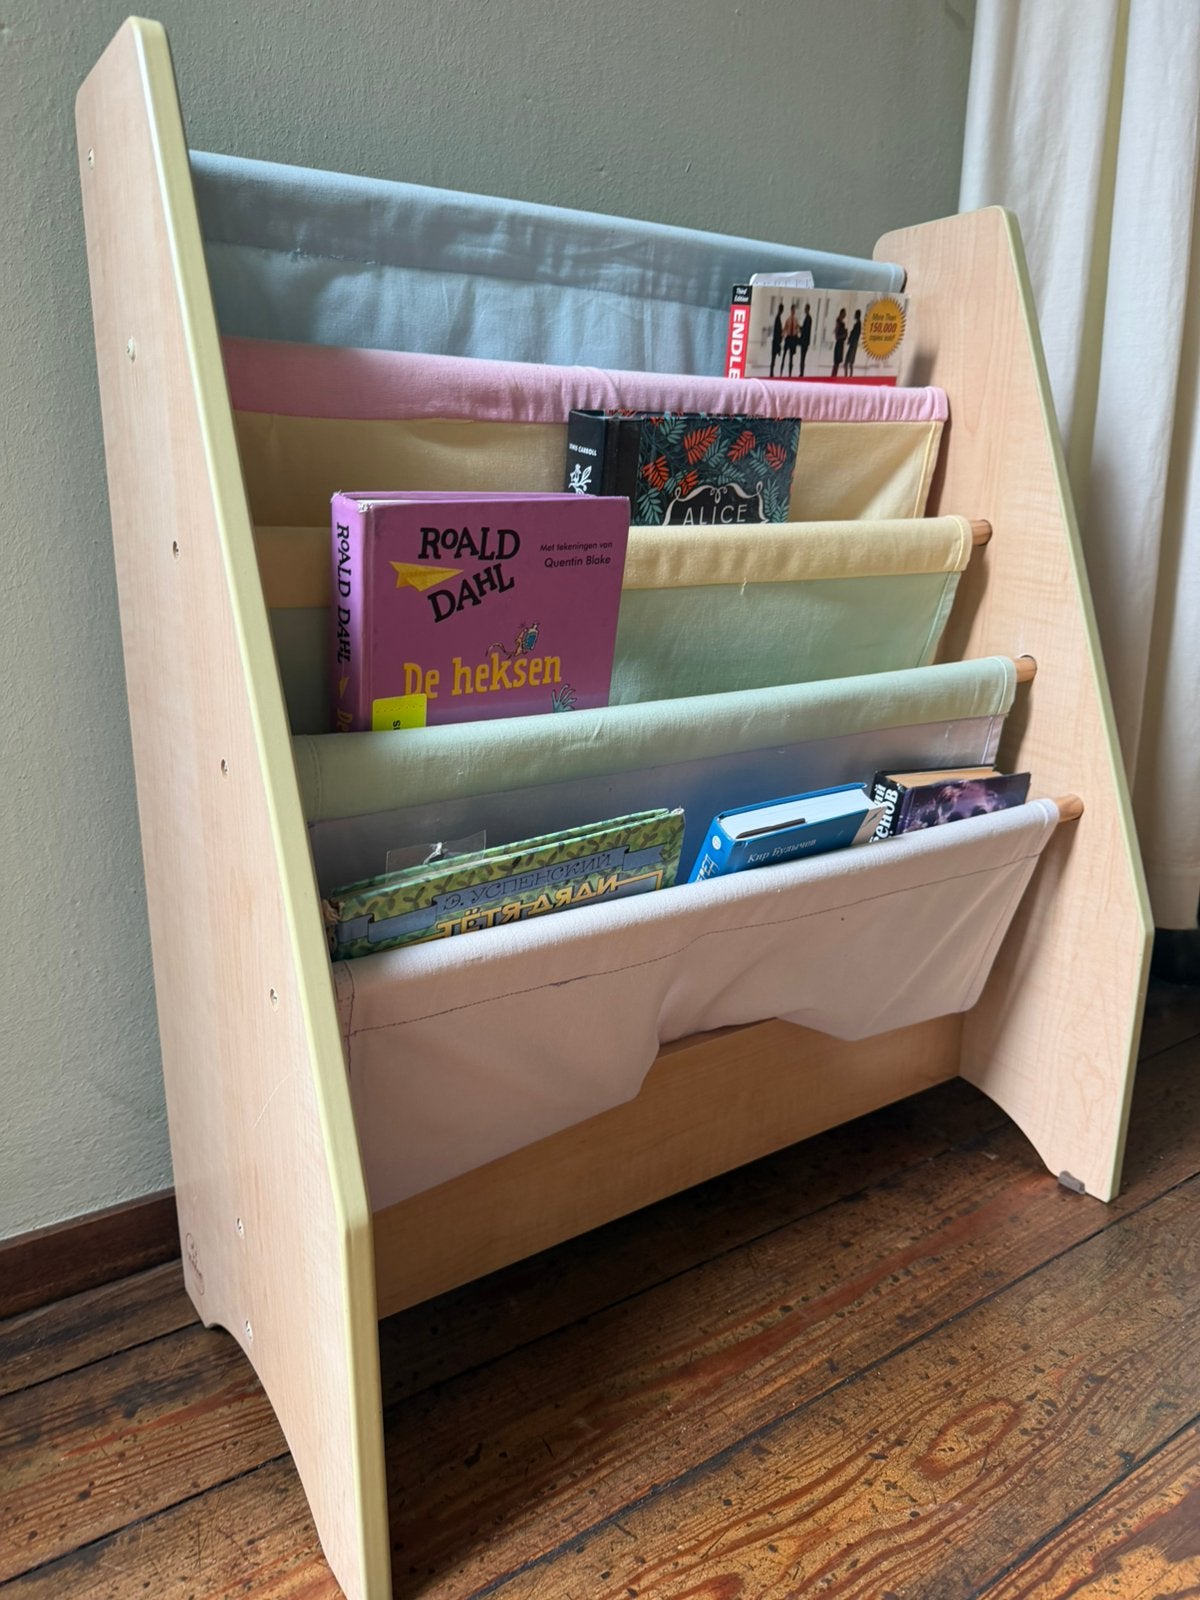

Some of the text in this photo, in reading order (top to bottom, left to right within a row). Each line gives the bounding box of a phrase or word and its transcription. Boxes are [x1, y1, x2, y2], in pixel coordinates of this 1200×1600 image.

[682, 504, 748, 525] ALICE
[336, 522, 352, 598] ROALD
[417, 527, 521, 561] ROALD
[540, 541, 613, 552] Met tekeningen van
[544, 554, 612, 568] Quentin Blake
[427, 563, 515, 623] DAHL
[336, 605, 352, 665] DAHL
[403, 652, 562, 699] De heksen
[472, 853, 612, 902] УСПЕНСКИЙ
[747, 852, 770, 864] Кир
[437, 874, 619, 937] ТЁТЯ ДЯДИ
